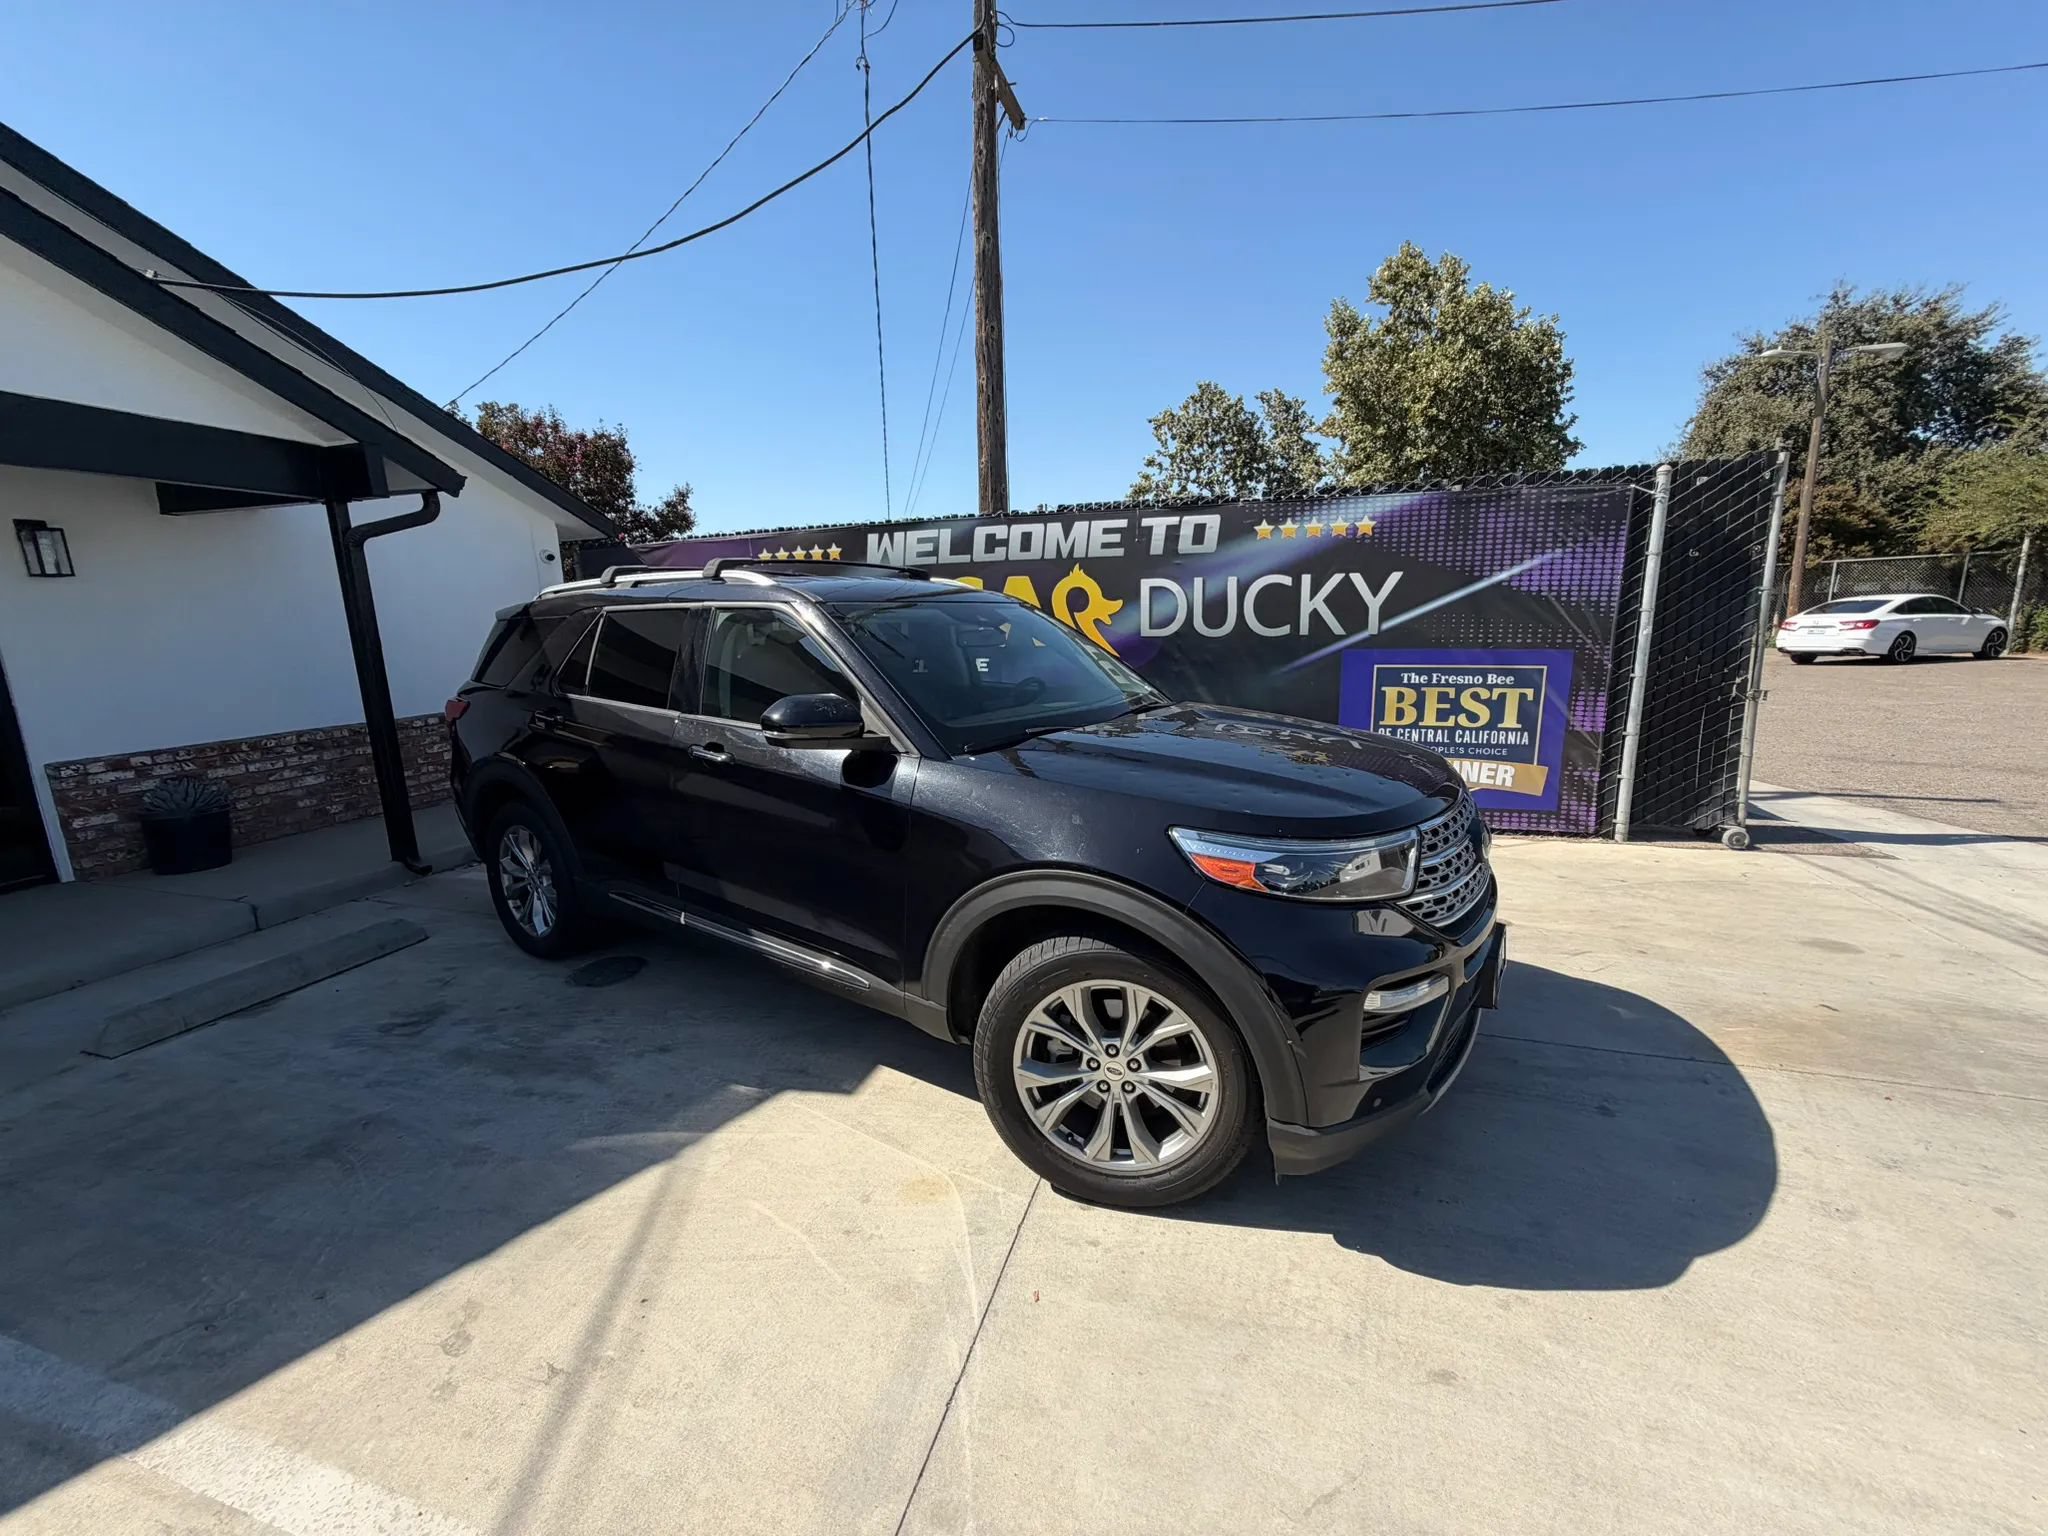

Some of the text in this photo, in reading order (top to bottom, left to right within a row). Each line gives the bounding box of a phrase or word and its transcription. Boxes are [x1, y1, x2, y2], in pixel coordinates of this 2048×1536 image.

[866, 514, 1221, 566] WELCOME TO
[1140, 571, 1403, 637] DUCKY
[1400, 672, 1515, 685] The Fresno Bee
[1379, 686, 1534, 728] BEST
[1397, 728, 1450, 743] CENTRAL
[1455, 730, 1529, 746] CALIFORNIA
[1468, 747, 1508, 756] CHOICE
